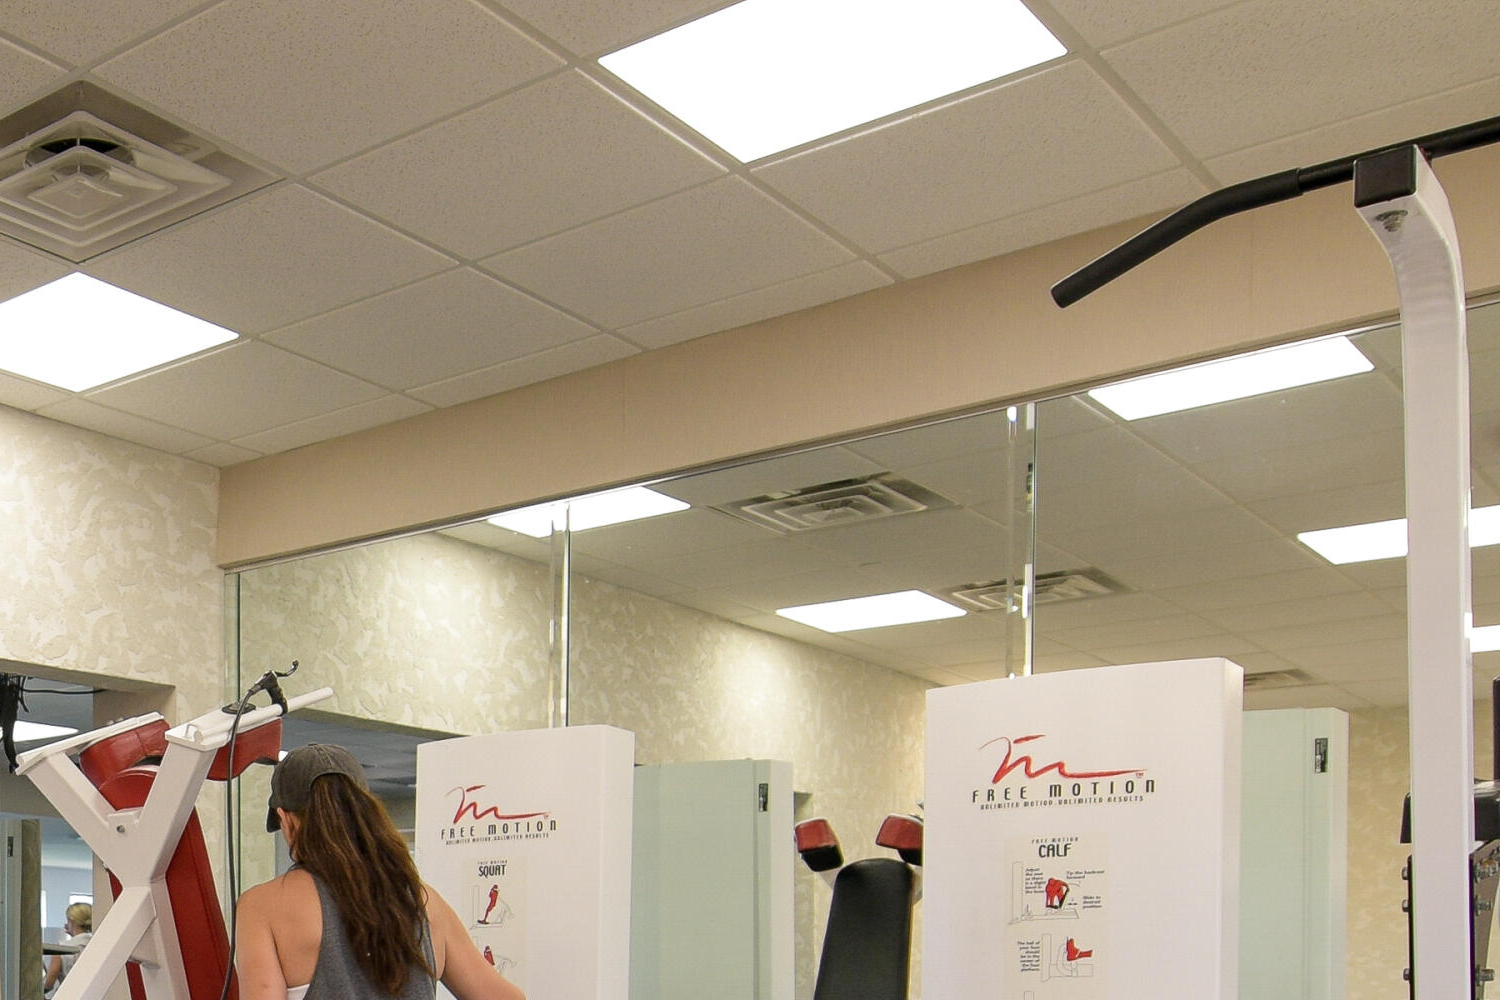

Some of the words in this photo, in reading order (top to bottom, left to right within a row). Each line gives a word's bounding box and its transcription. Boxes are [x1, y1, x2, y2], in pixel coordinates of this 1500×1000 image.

[972, 786, 1028, 803] FREE
[1049, 779, 1156, 798] MOTION
[981, 802, 1020, 811] UNLIMITED
[1107, 795, 1145, 803] RESULTS
[441, 826, 476, 840] FREE
[488, 820, 557, 836] MOTION
[1038, 843, 1072, 858] CALF
[478, 865, 506, 878] SQUAT
